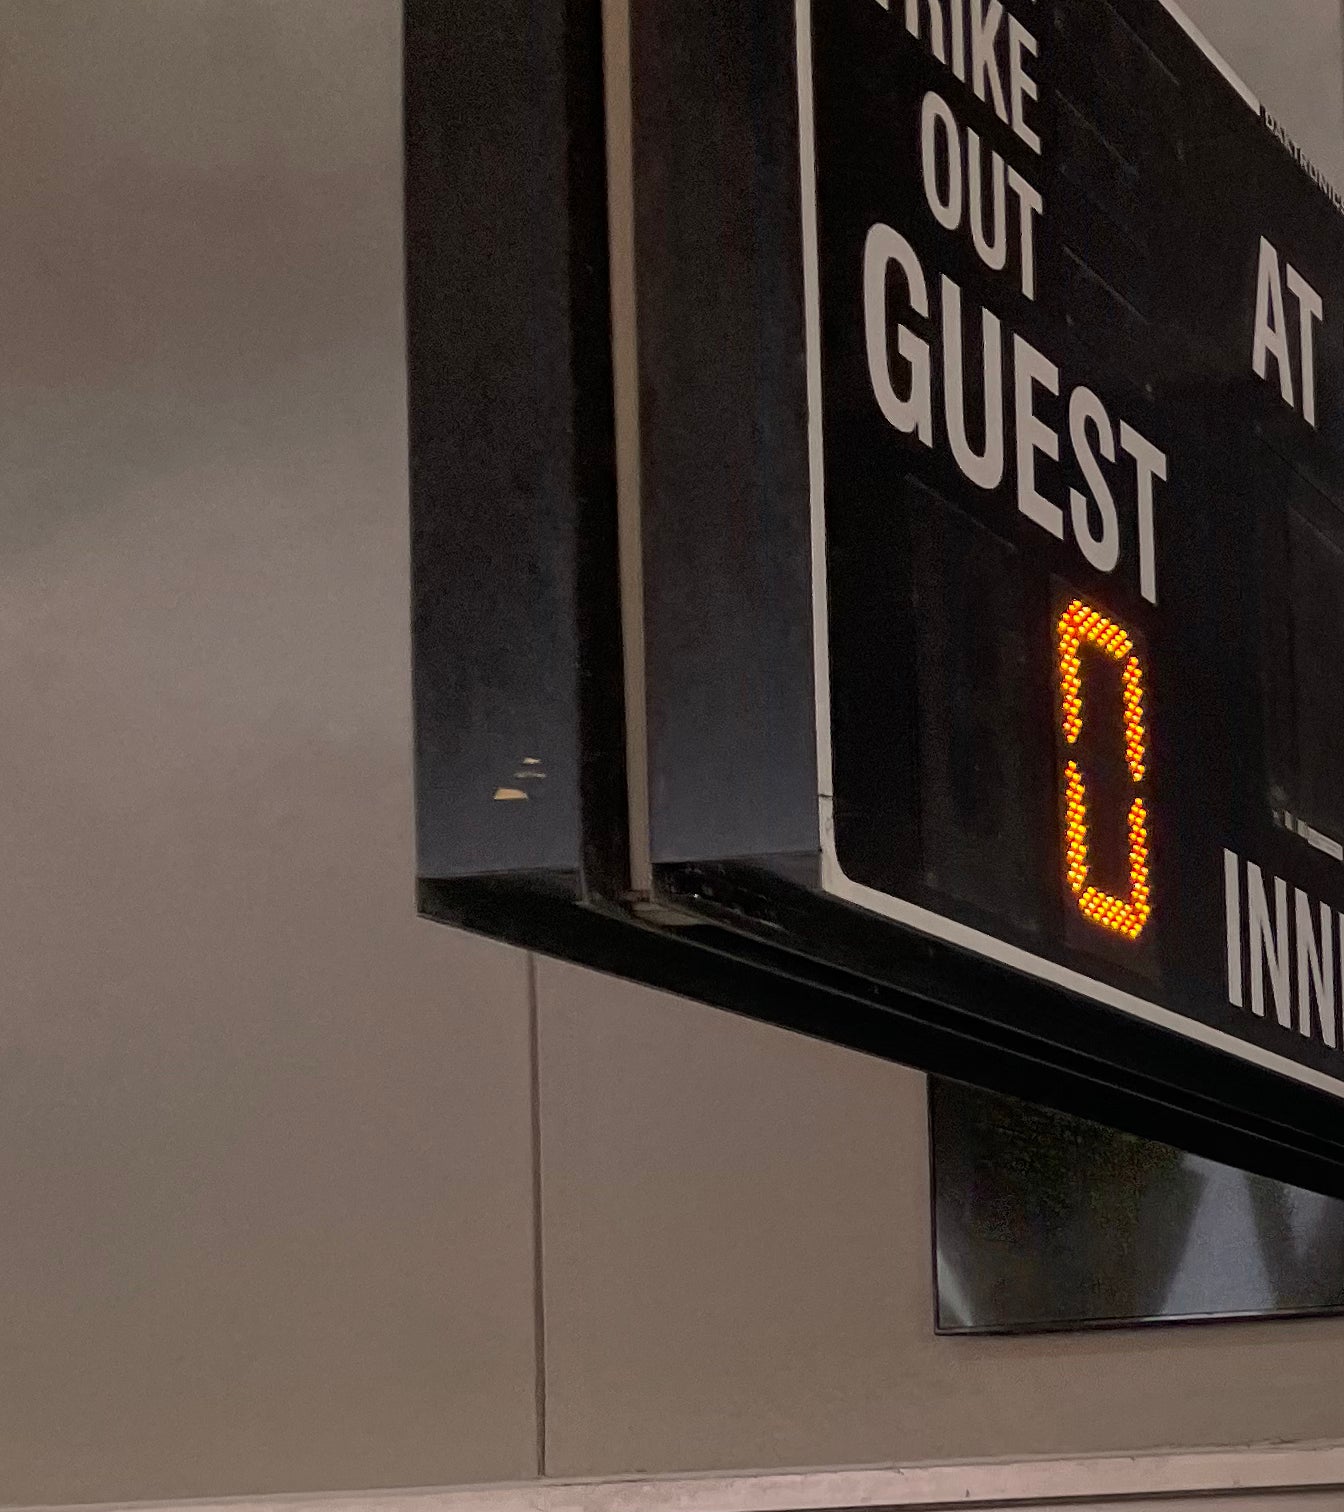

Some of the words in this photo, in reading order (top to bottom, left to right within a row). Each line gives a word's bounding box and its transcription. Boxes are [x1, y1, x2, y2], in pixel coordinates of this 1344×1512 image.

[921, 91, 1043, 300] OUT
[1252, 236, 1324, 428] AT
[864, 224, 1167, 604] GUEST
[1057, 600, 1151, 940] 0
